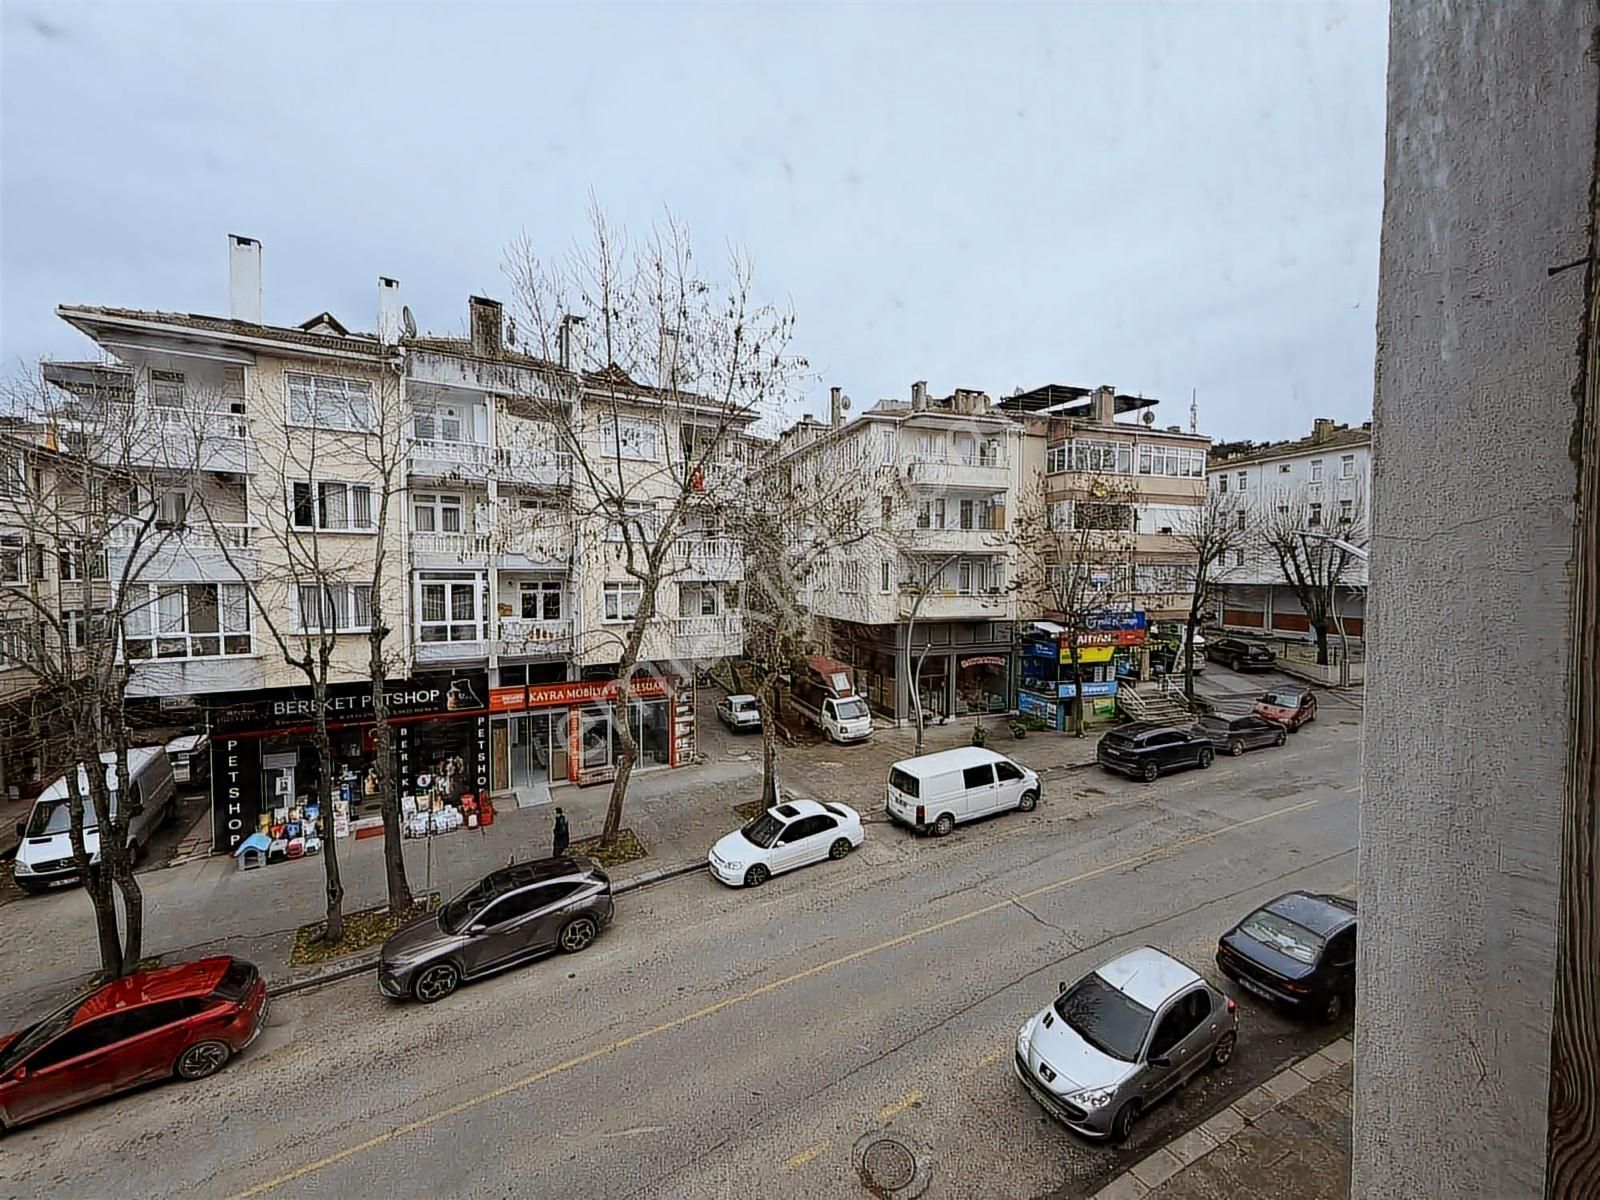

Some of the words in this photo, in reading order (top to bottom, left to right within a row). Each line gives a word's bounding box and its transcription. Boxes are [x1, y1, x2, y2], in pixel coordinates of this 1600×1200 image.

[274, 696, 357, 715] BEREKET
[361, 689, 440, 708] PTSHOP
[529, 688, 563, 703] KAYRA
[227, 740, 242, 847] PETSHOP
